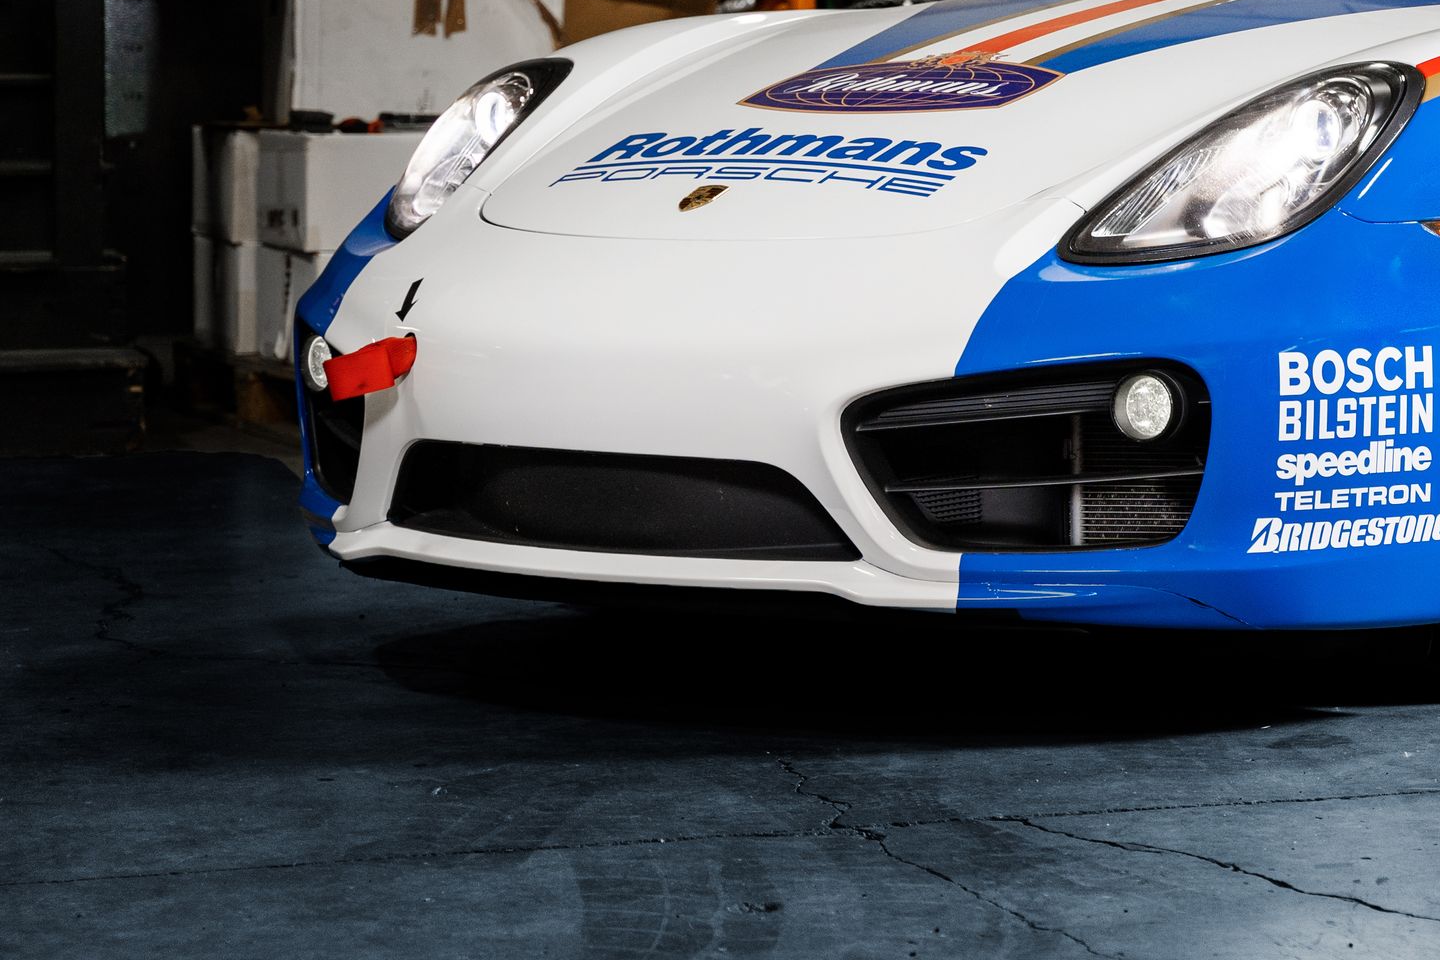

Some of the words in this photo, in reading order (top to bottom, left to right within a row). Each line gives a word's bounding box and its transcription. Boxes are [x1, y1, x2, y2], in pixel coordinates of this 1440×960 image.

[585, 127, 988, 171] Rothmans
[547, 166, 948, 198] PORSCHE
[1278, 345, 1434, 397] BOSCH
[1278, 392, 1434, 442] BILSTEIN
[1275, 438, 1433, 486] speedline
[1274, 482, 1432, 512] TELETRON
